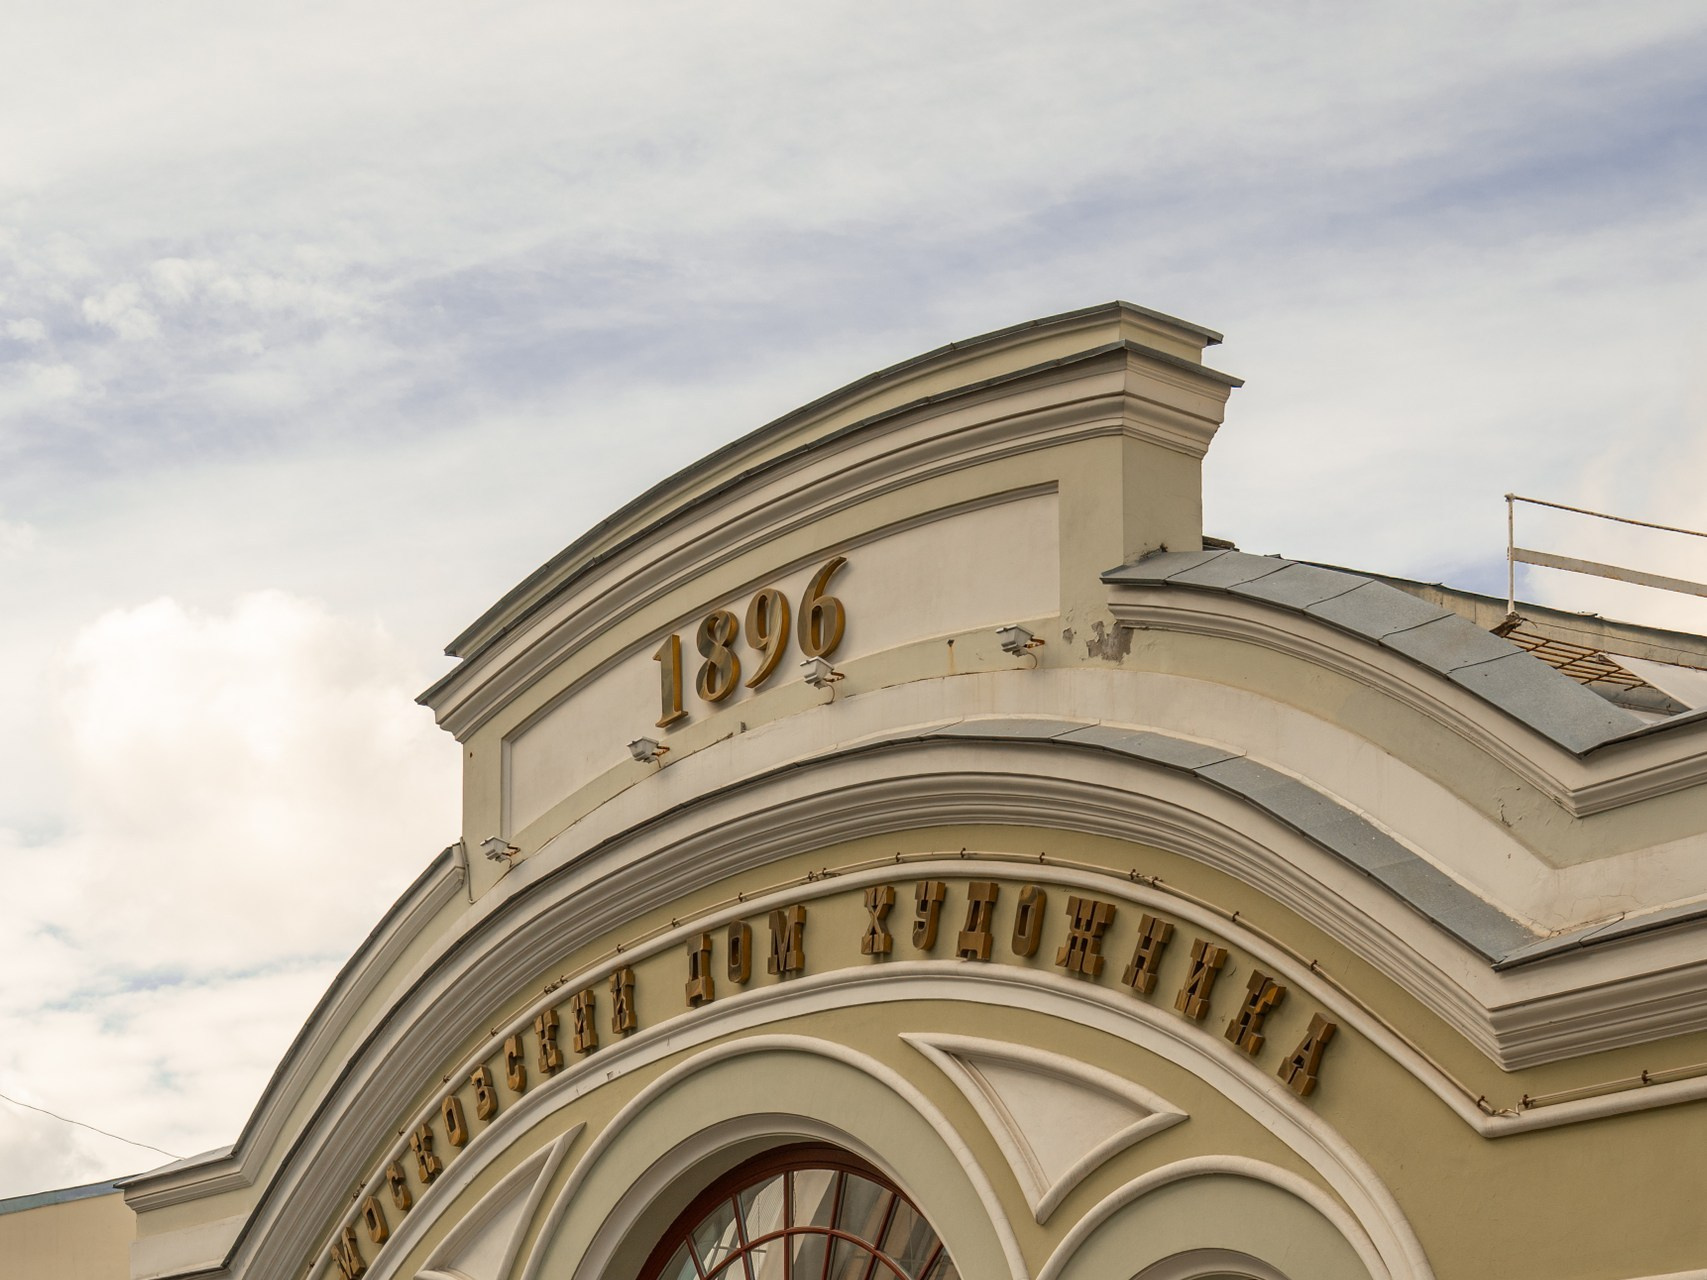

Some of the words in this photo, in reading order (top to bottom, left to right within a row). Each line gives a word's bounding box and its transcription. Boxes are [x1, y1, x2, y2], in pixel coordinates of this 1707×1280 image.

[652, 556, 848, 728] 1896
[684, 903, 807, 1008] ДОМ
[860, 880, 1338, 1098] ХУДОЖНИКА
